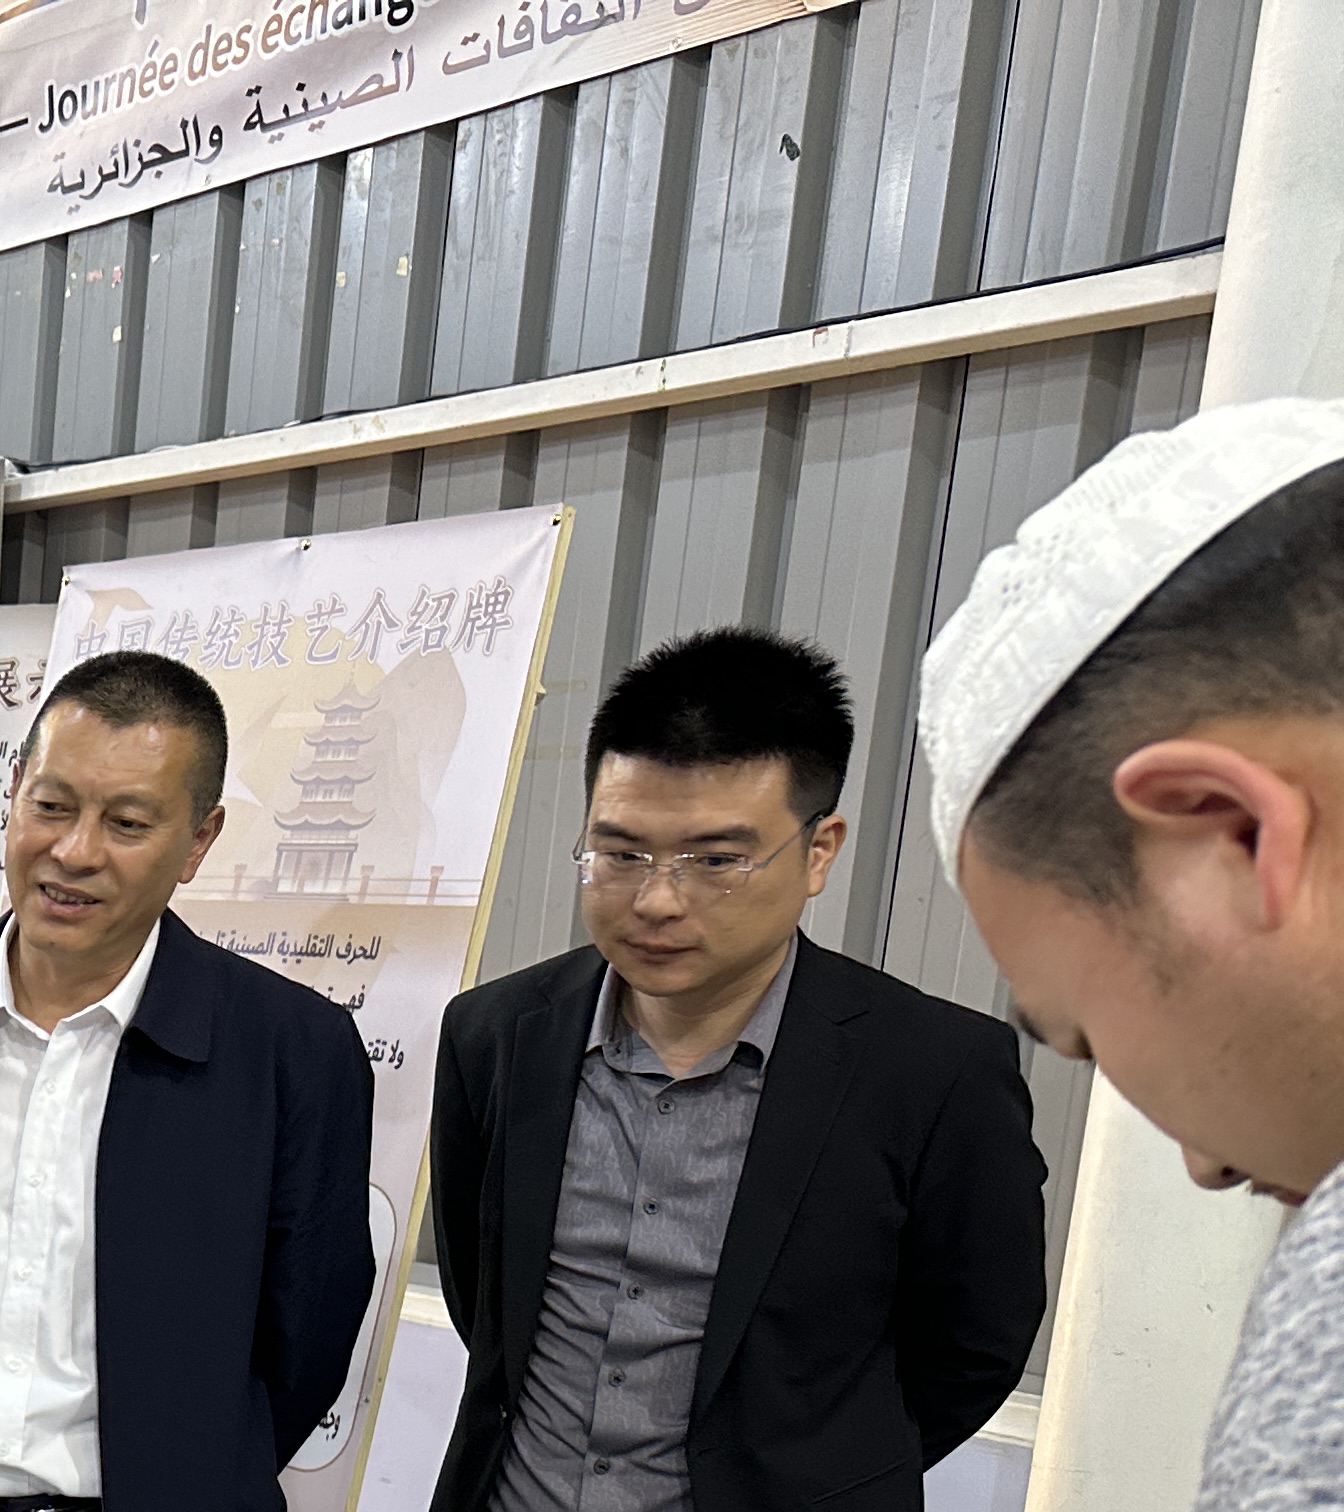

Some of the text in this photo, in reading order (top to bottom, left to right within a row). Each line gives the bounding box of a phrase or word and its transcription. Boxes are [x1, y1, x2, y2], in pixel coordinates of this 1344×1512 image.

[38, 40, 179, 134] Journée
[188, 23, 253, 81] des
[242, 47, 415, 146] الصينية
[46, 113, 224, 216] والجزائرية
[276, 932, 335, 965] التقليدية
[335, 933, 382, 965] للحرف
